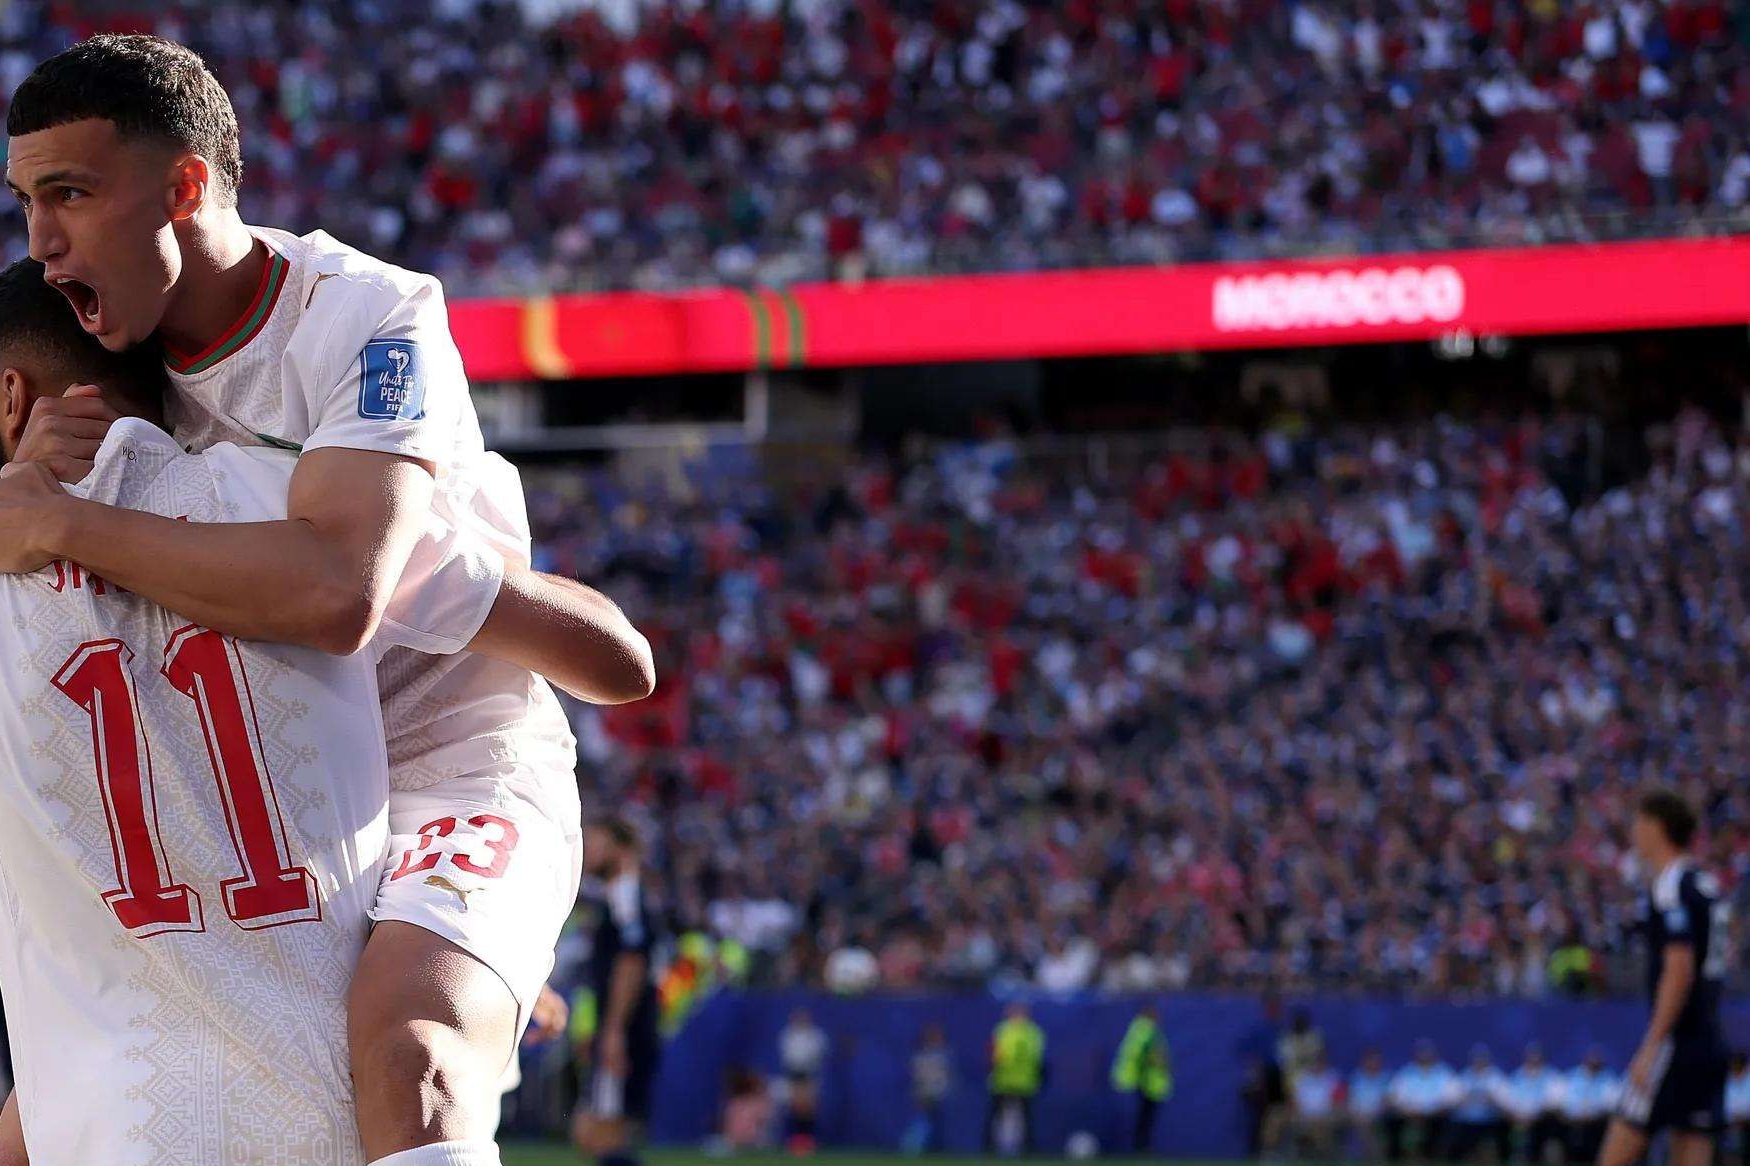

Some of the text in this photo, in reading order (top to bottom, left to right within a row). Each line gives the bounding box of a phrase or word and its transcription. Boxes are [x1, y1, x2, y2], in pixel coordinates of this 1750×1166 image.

[1212, 265, 1464, 332] MOROCCO
[50, 622, 322, 939] 11
[390, 814, 520, 882] 23
